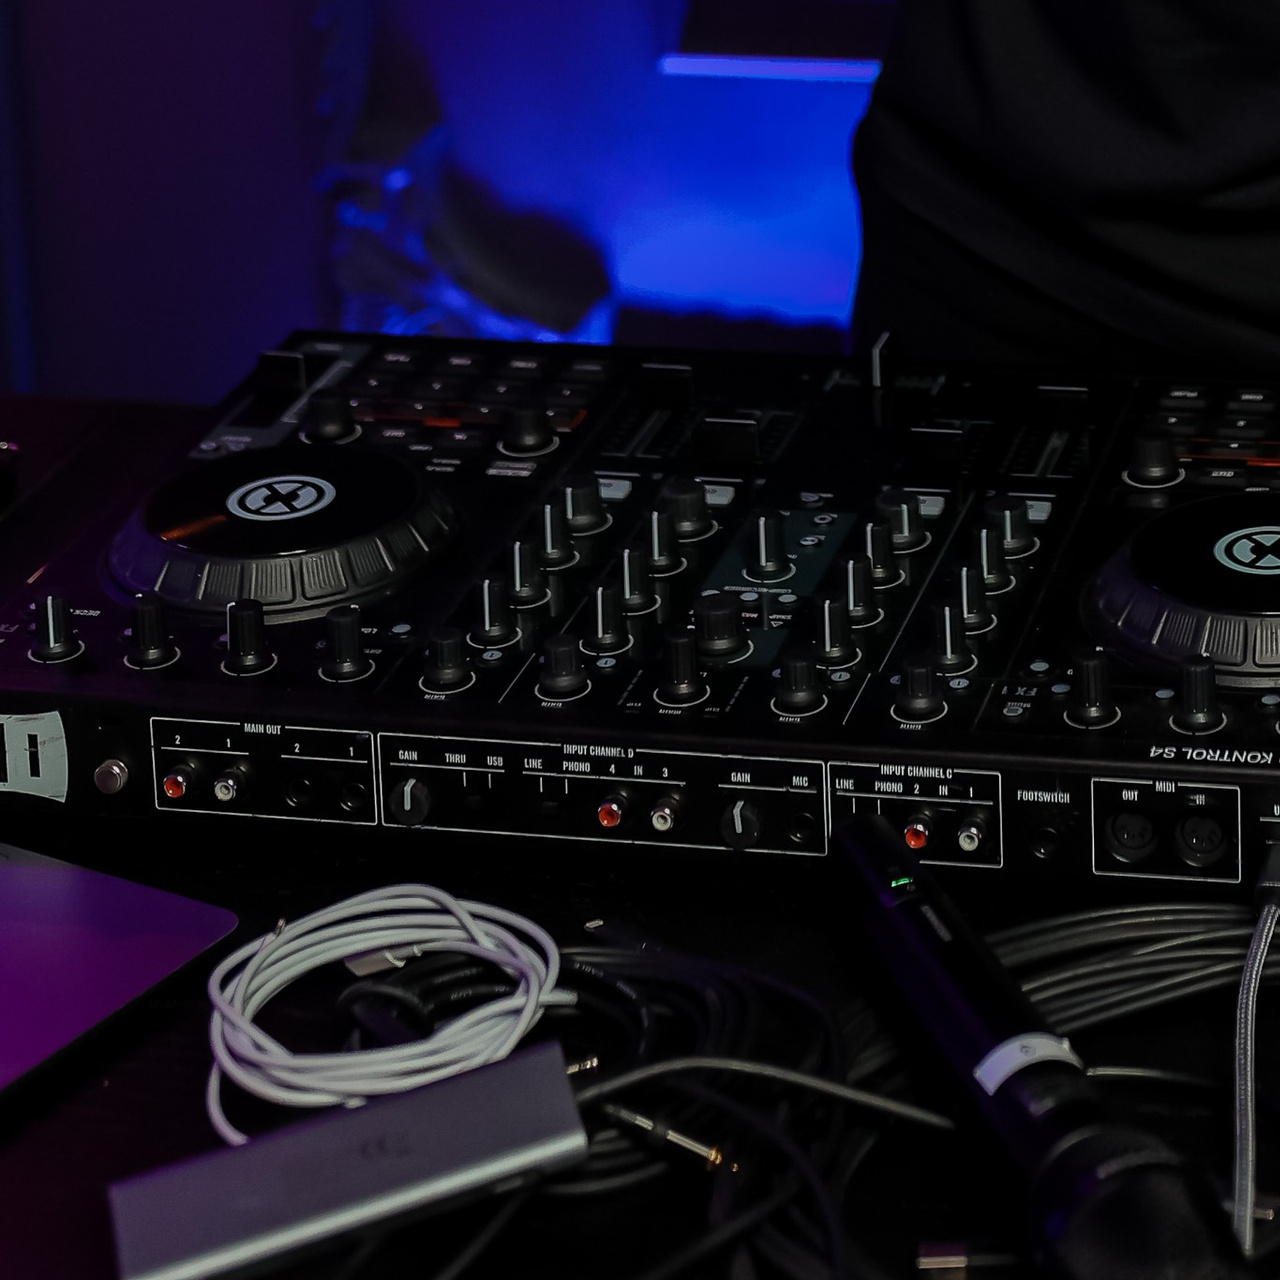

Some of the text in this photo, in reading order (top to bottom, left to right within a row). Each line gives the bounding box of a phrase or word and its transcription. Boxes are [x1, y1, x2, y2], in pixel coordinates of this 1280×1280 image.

[244, 723, 282, 735] MAIN OUT
[175, 735, 181, 745] 2
[294, 743, 300, 753] 2
[563, 743, 588, 756] INPUT
[589, 745, 626, 758] CHANNEL
[1149, 745, 1176, 759] S4
[398, 750, 418, 761] GAIN
[445, 753, 467, 764] THRU
[1181, 746, 1273, 764] KONTROL
[487, 756, 503, 767] USB
[524, 758, 543, 769] LINE
[562, 761, 591, 773] PHONO
[609, 764, 616, 774] 4
[633, 765, 643, 776] IN
[662, 767, 668, 778] 3
[880, 764, 906, 777] INPUT
[907, 765, 945, 779] CHANNEL
[731, 772, 751, 783] GAIN
[792, 776, 808, 787] MIC
[835, 778, 854, 790] LINE
[874, 781, 903, 793] PHONO
[913, 784, 920, 795] 2
[1155, 781, 1176, 794] MIDI
[938, 785, 948, 796] IN
[1122, 790, 1139, 802] OUT
[1017, 789, 1070, 804] FOOTSWITCH
